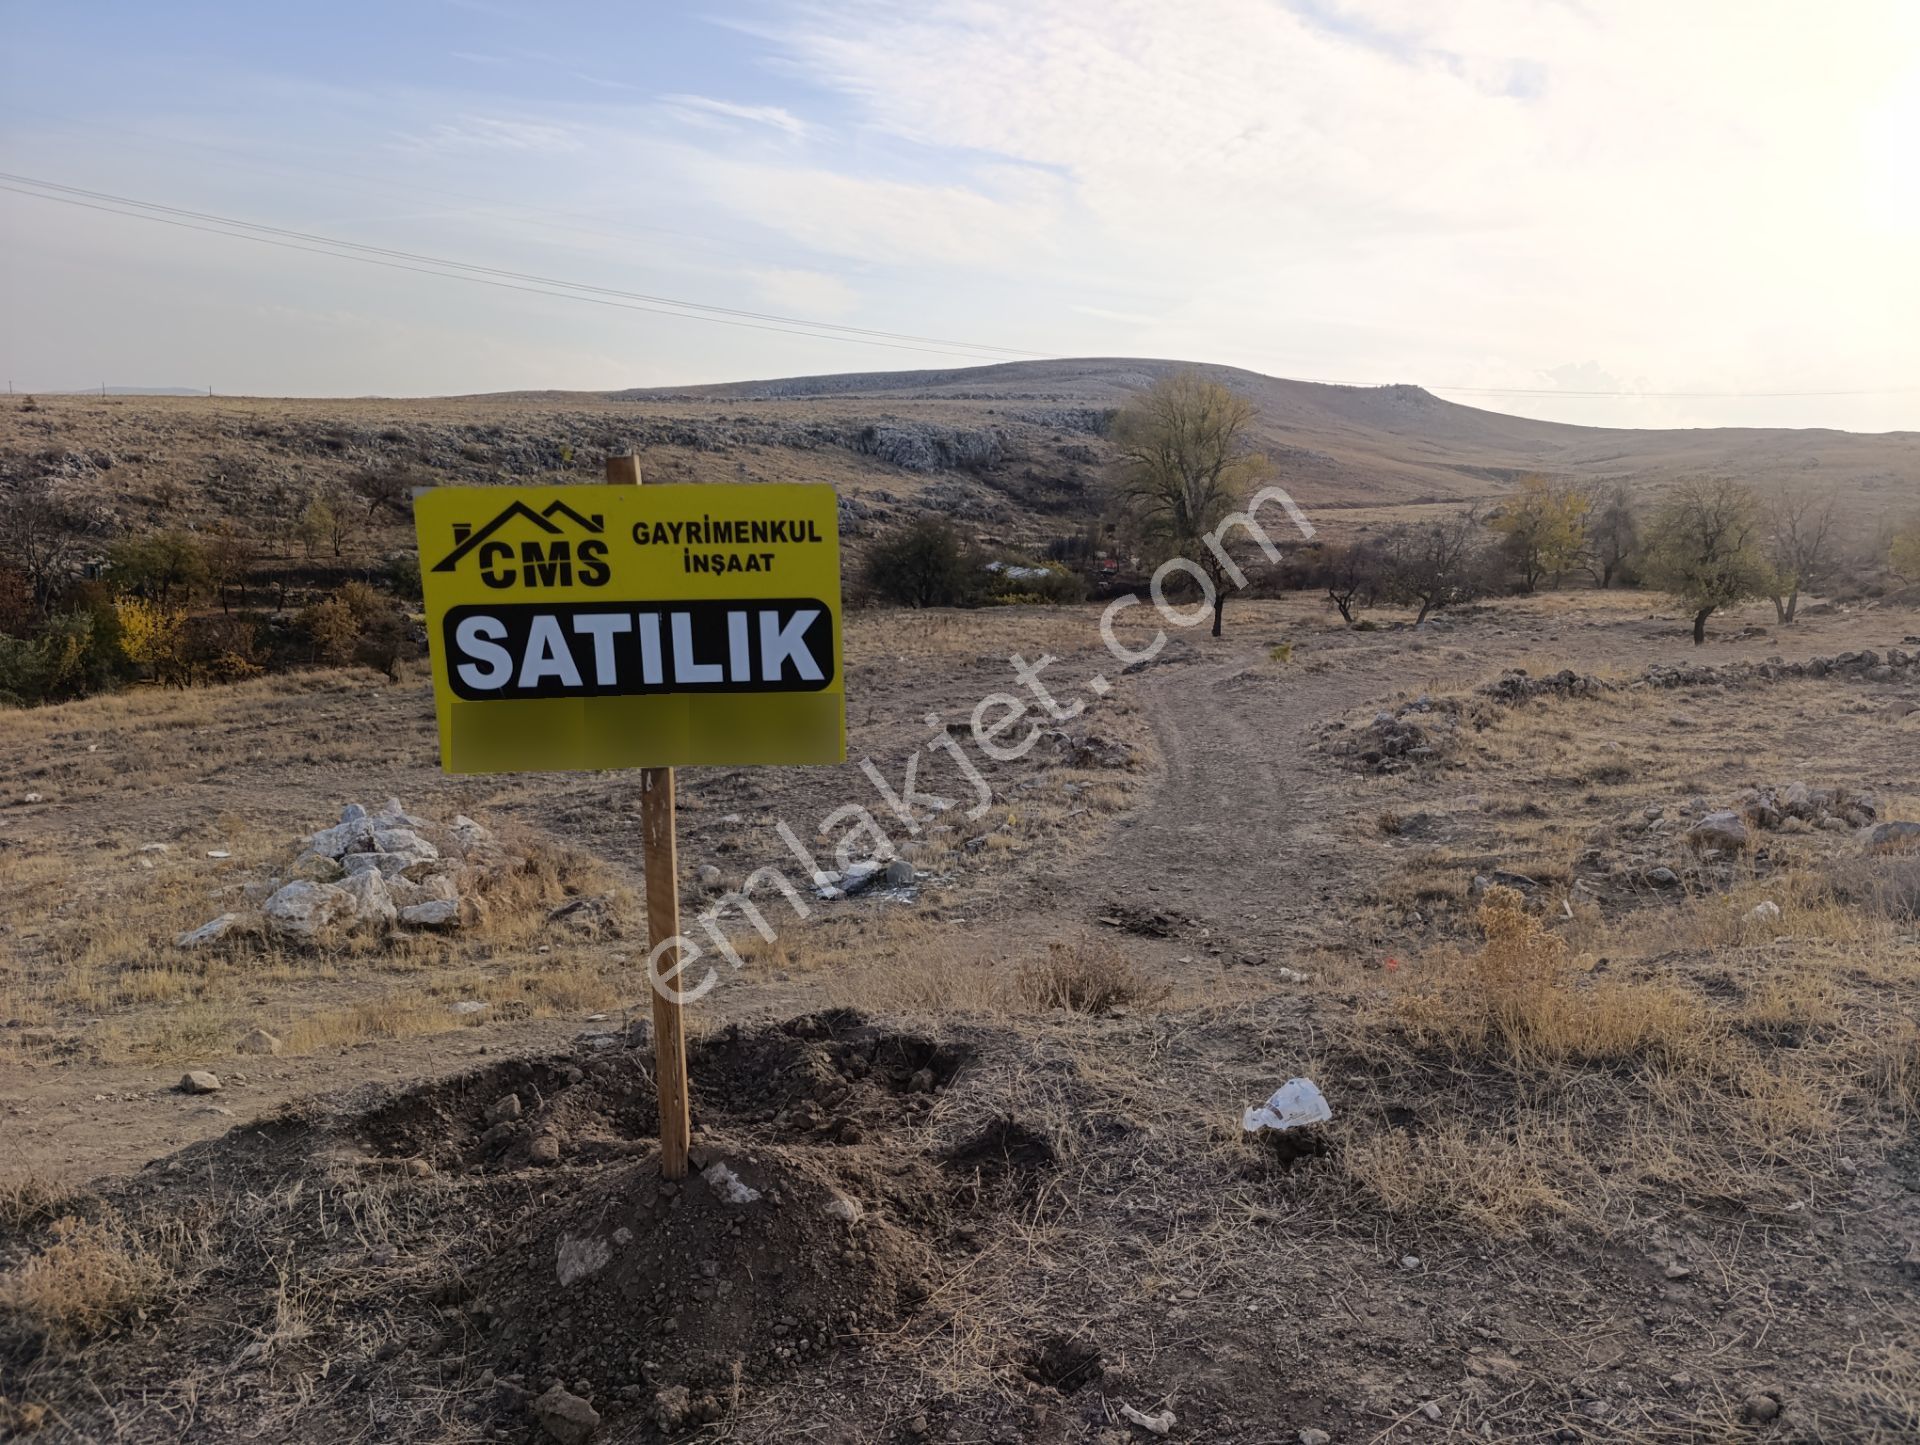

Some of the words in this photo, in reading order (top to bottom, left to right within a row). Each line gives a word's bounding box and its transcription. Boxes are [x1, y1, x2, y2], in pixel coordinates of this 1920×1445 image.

[632, 514, 823, 546] GAYRİMENKUL
[479, 540, 611, 589] CMS
[684, 547, 775, 576] İNŞAAT
[456, 609, 825, 690] SATILIK
